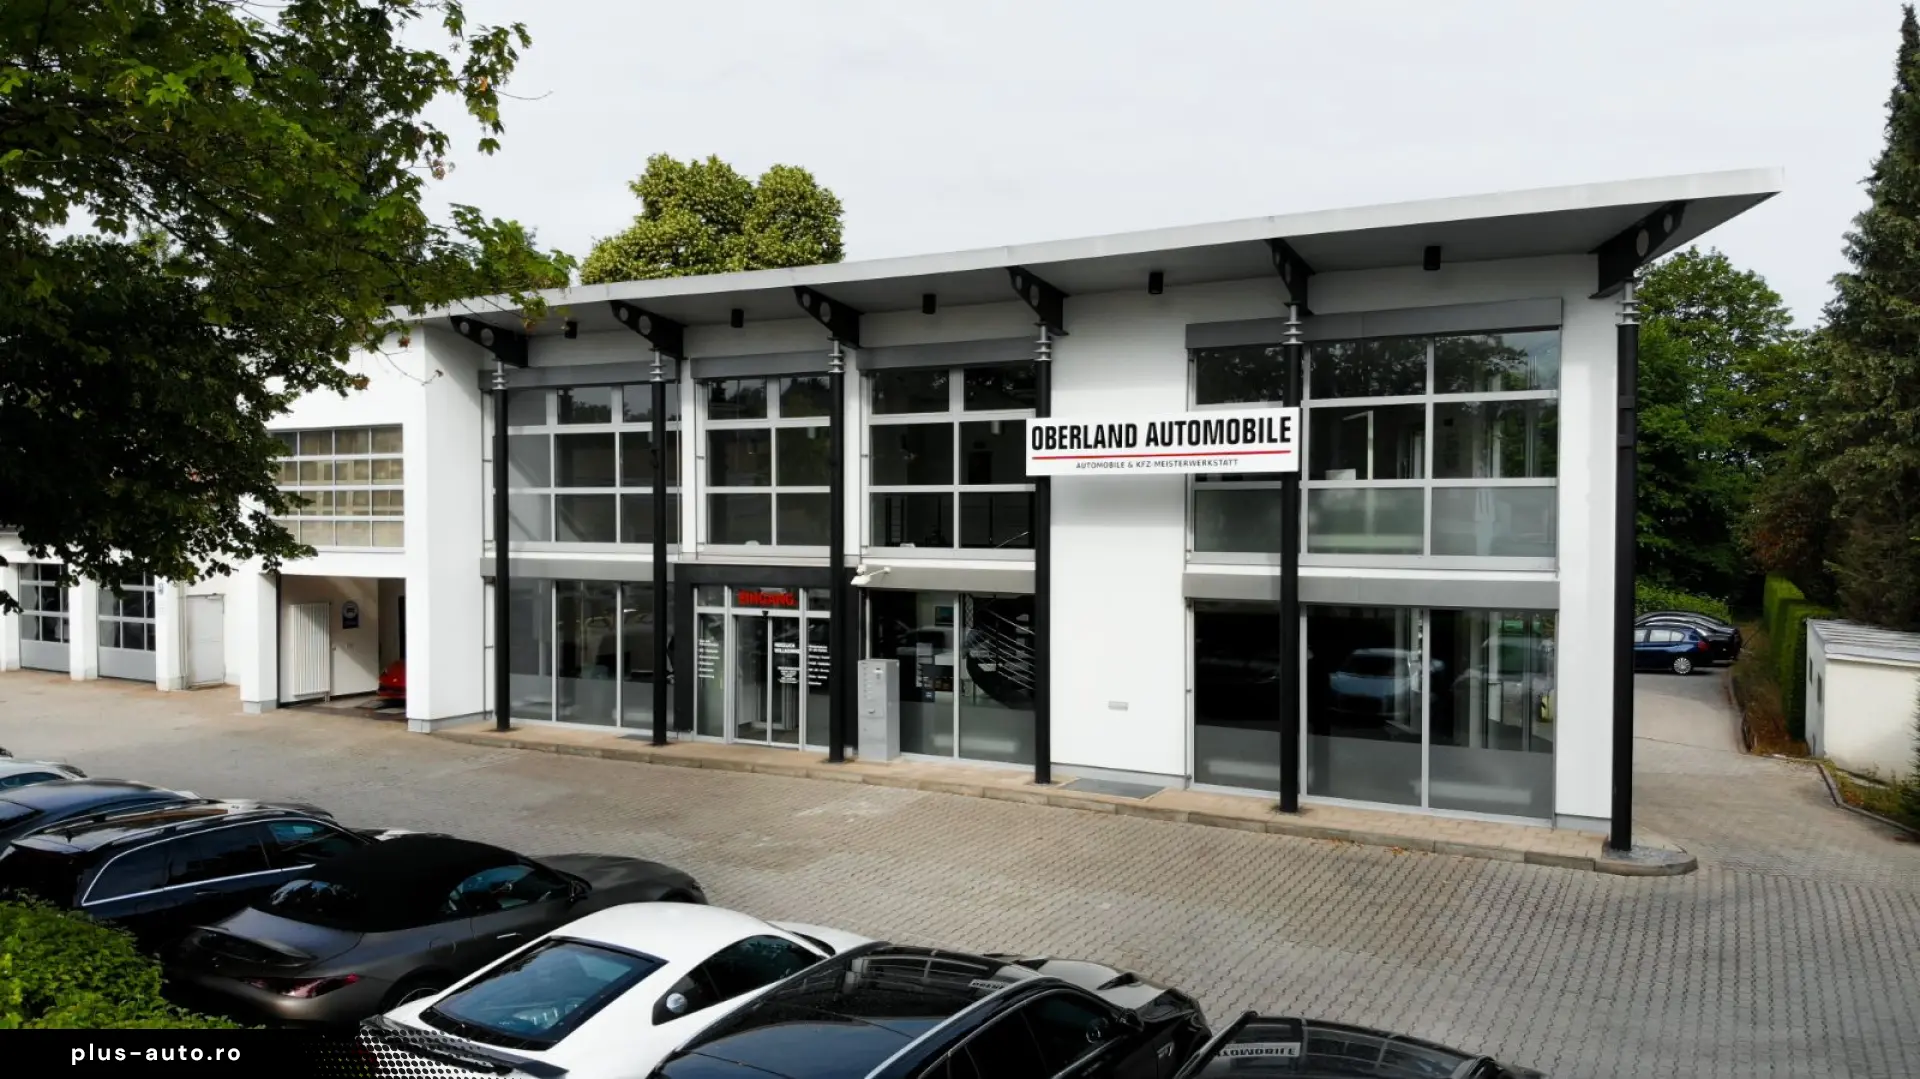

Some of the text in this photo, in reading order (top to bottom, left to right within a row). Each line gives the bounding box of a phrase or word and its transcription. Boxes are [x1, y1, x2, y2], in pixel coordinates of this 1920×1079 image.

[1031, 416, 1292, 451] OBERLAND AUTOMOBILE
[1075, 461, 1125, 469] AUTOMOBILE
[1127, 461, 1134, 469] &
[1153, 458, 1239, 468] MEISTERWERKSTATT
